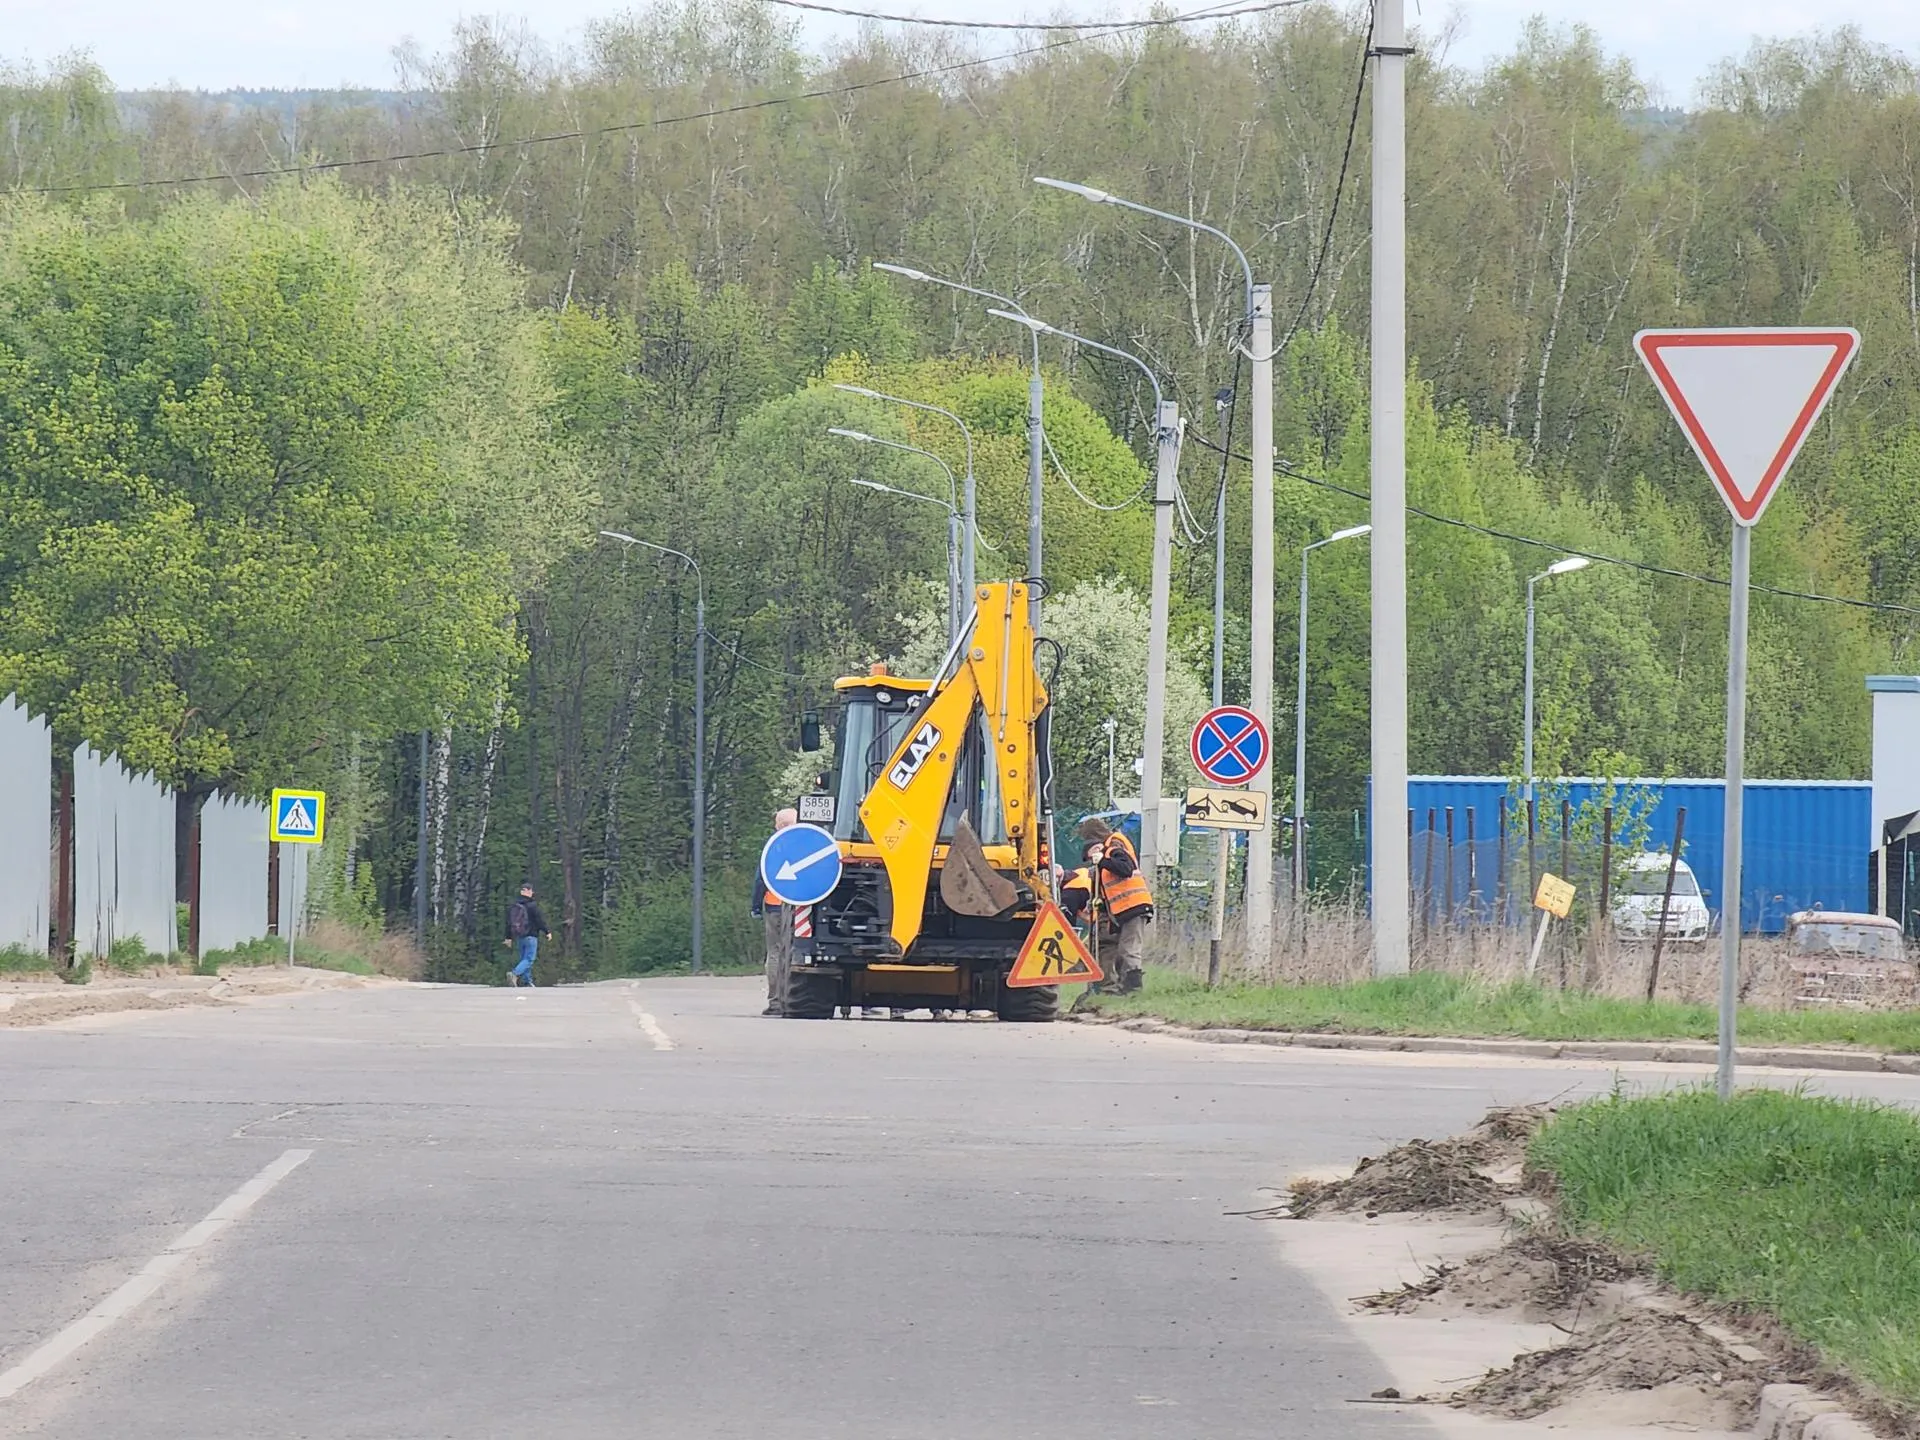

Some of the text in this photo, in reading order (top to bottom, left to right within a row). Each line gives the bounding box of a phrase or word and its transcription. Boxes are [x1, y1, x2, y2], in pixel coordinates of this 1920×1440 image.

[889, 722, 941, 789] ELAZ
[804, 797, 830, 808] 5858
[821, 809, 832, 817] 50
